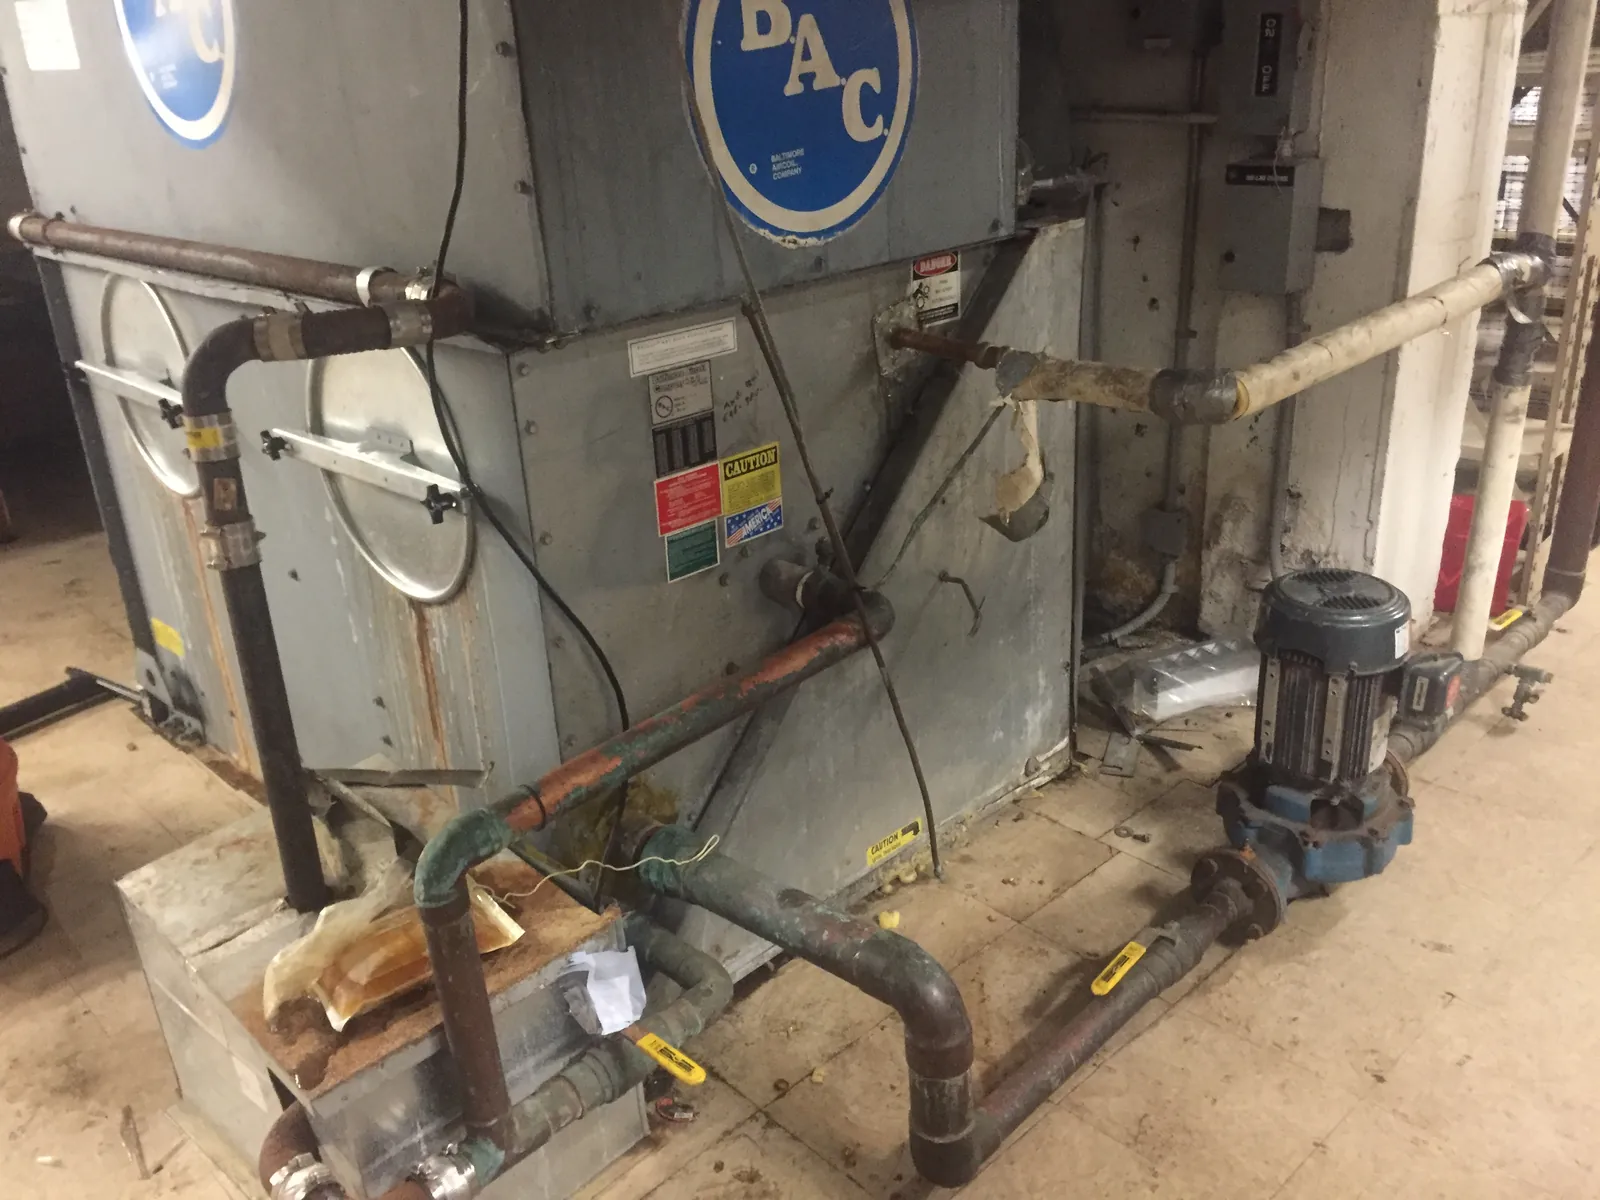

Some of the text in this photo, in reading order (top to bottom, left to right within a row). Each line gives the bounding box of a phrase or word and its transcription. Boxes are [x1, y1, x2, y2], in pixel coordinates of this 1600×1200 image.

[773, 166, 801, 180] COMPANY
[725, 450, 777, 478] CAUTION
[871, 831, 899, 855] CAUTION
